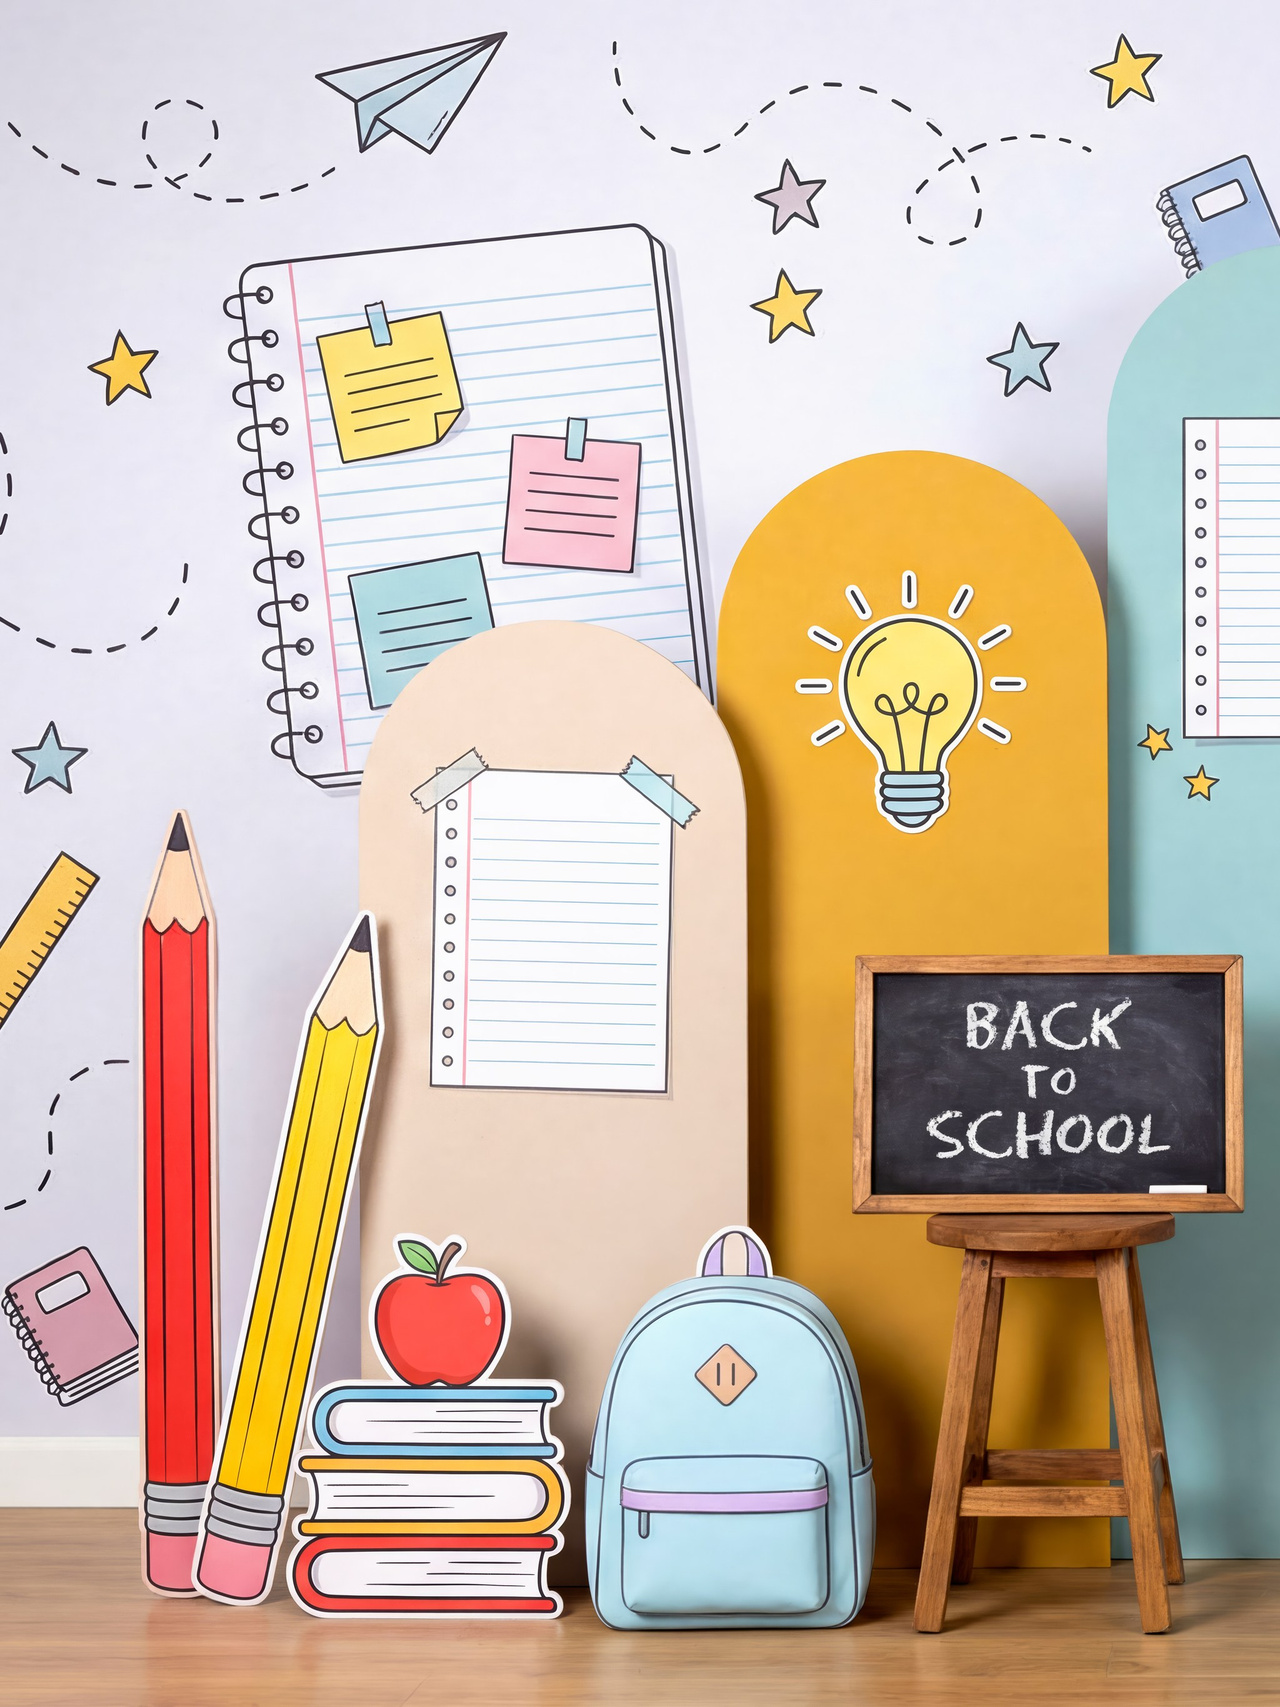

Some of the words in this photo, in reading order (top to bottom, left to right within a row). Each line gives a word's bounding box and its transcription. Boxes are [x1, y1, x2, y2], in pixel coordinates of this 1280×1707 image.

[966, 997, 1132, 1050] BACK
[1021, 1063, 1076, 1098] TO
[926, 1109, 1171, 1159] SCHOOL
